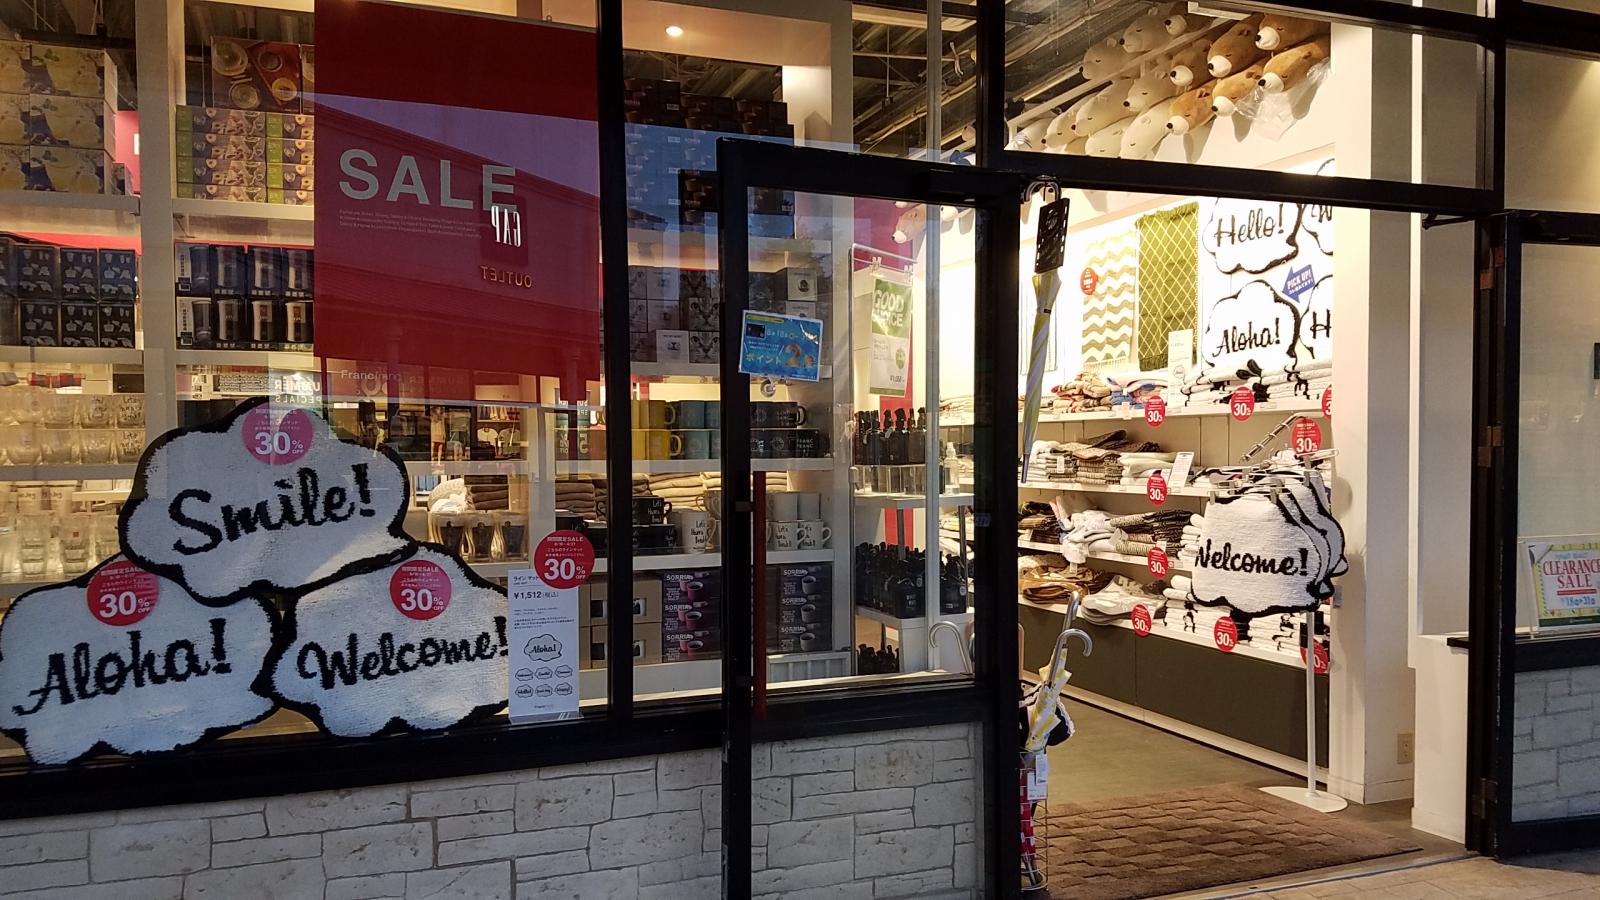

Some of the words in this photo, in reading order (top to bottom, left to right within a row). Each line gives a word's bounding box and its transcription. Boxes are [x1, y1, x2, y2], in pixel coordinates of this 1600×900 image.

[339, 148, 517, 212] SALE
[1213, 204, 1284, 247] Hello!
[1212, 317, 1281, 358] Aloha!
[168, 463, 376, 555] Smile!
[1557, 574, 1592, 588] SALE
[12, 617, 232, 716] Aloha!
[297, 616, 508, 690] Welcome!
[529, 644, 557, 654] Aloha!
